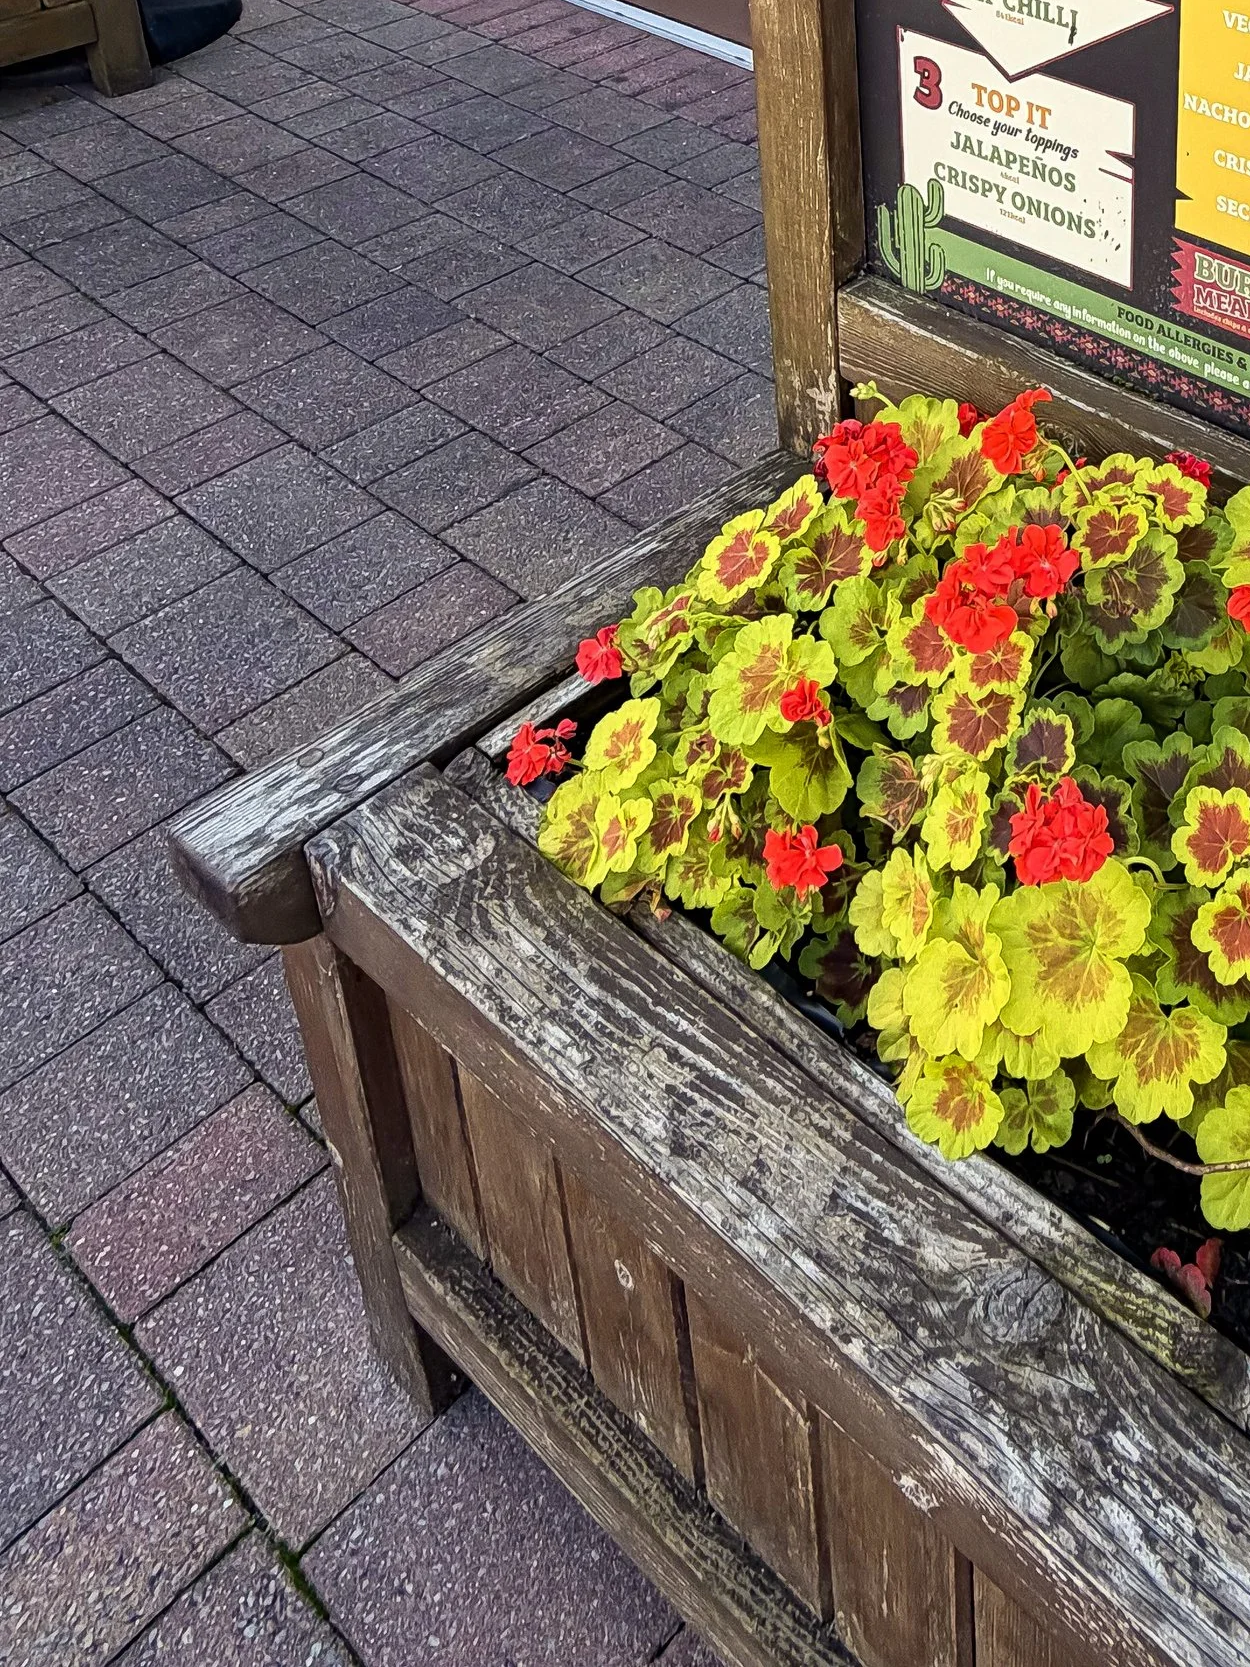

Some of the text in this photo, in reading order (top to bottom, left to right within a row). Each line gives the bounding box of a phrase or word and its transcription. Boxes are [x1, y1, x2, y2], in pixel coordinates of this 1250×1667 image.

[948, 101, 1079, 162] Choose your toppings
[972, 83, 1051, 129] TOP IT
[950, 131, 1076, 192] JALAPEÑOS
[934, 162, 1096, 239] CRISPY ONIONS
[1116, 307, 1154, 331] FOOD
[1157, 324, 1234, 365] ALLERGIES
[1236, 356, 1248, 371] &
[1168, 345, 1200, 368] above
[1204, 363, 1240, 385] please
